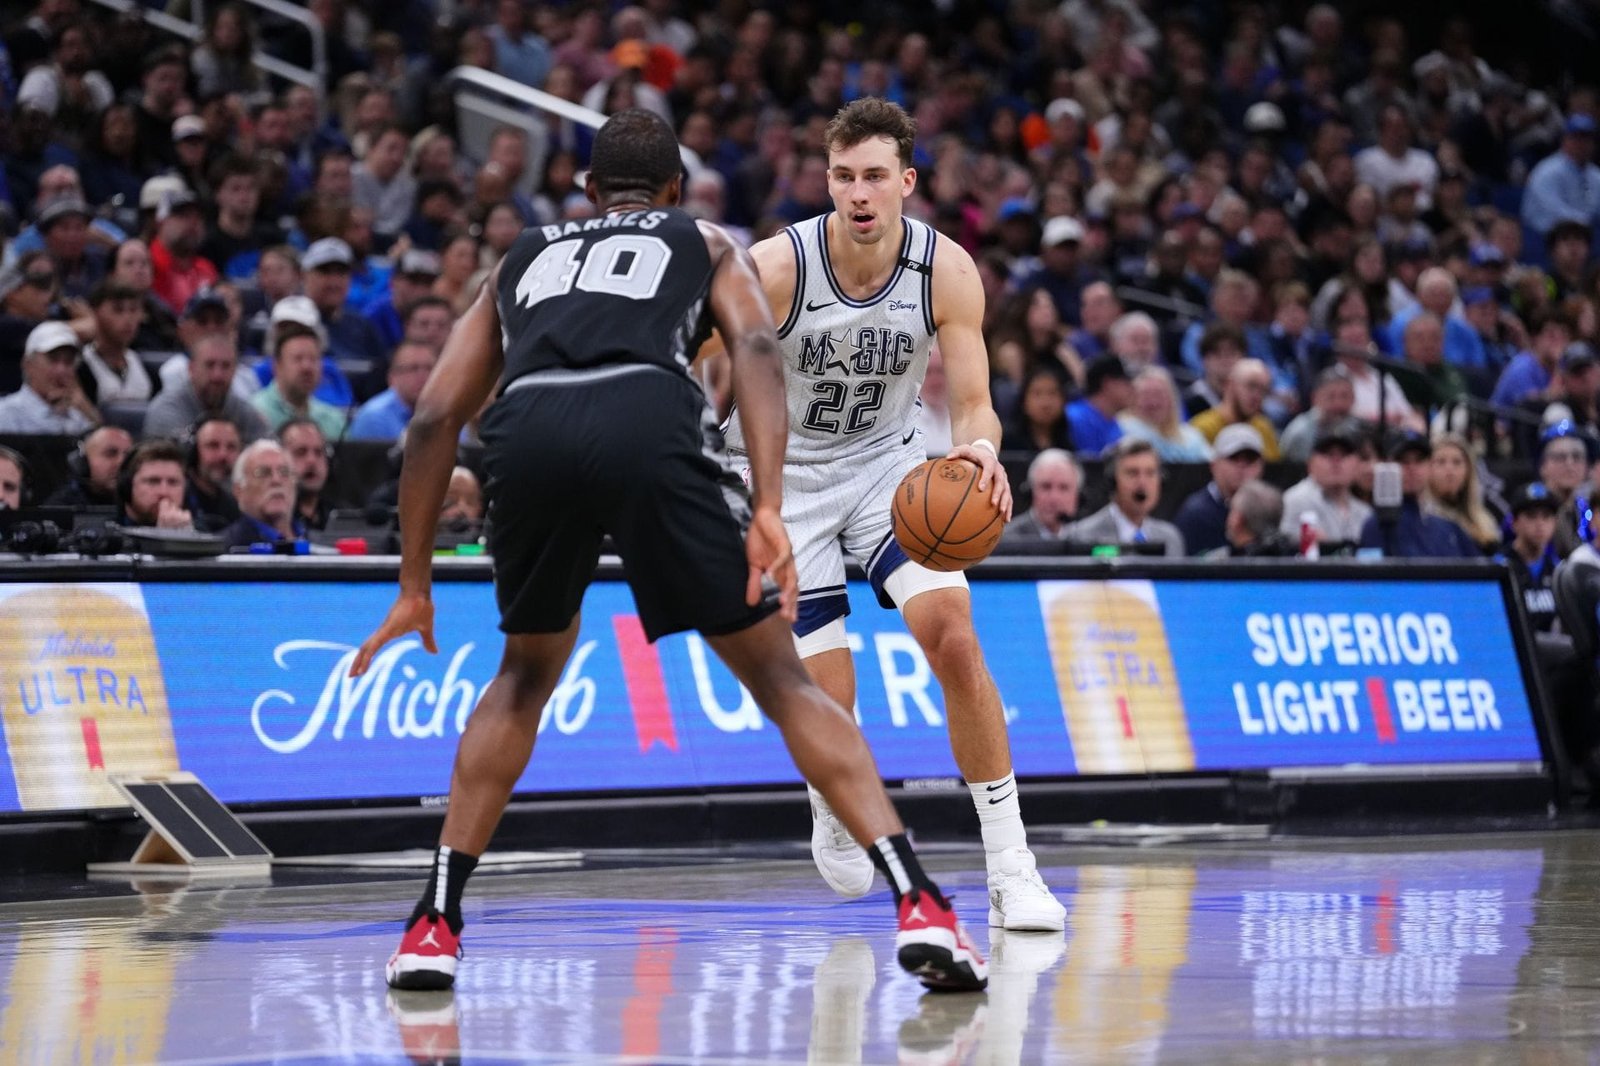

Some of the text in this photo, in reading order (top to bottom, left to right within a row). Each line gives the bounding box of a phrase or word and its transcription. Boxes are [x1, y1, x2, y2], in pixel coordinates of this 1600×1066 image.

[540, 210, 669, 242] BARNES
[514, 234, 673, 309] 40
[887, 299, 918, 313] Disney
[798, 326, 915, 376] MGIC
[802, 379, 887, 435] 22
[1246, 611, 1459, 667] SUPERIOR
[18, 666, 148, 715] ULTRA
[251, 638, 599, 754] Michb
[1232, 678, 1502, 735] LIGHT BEER
